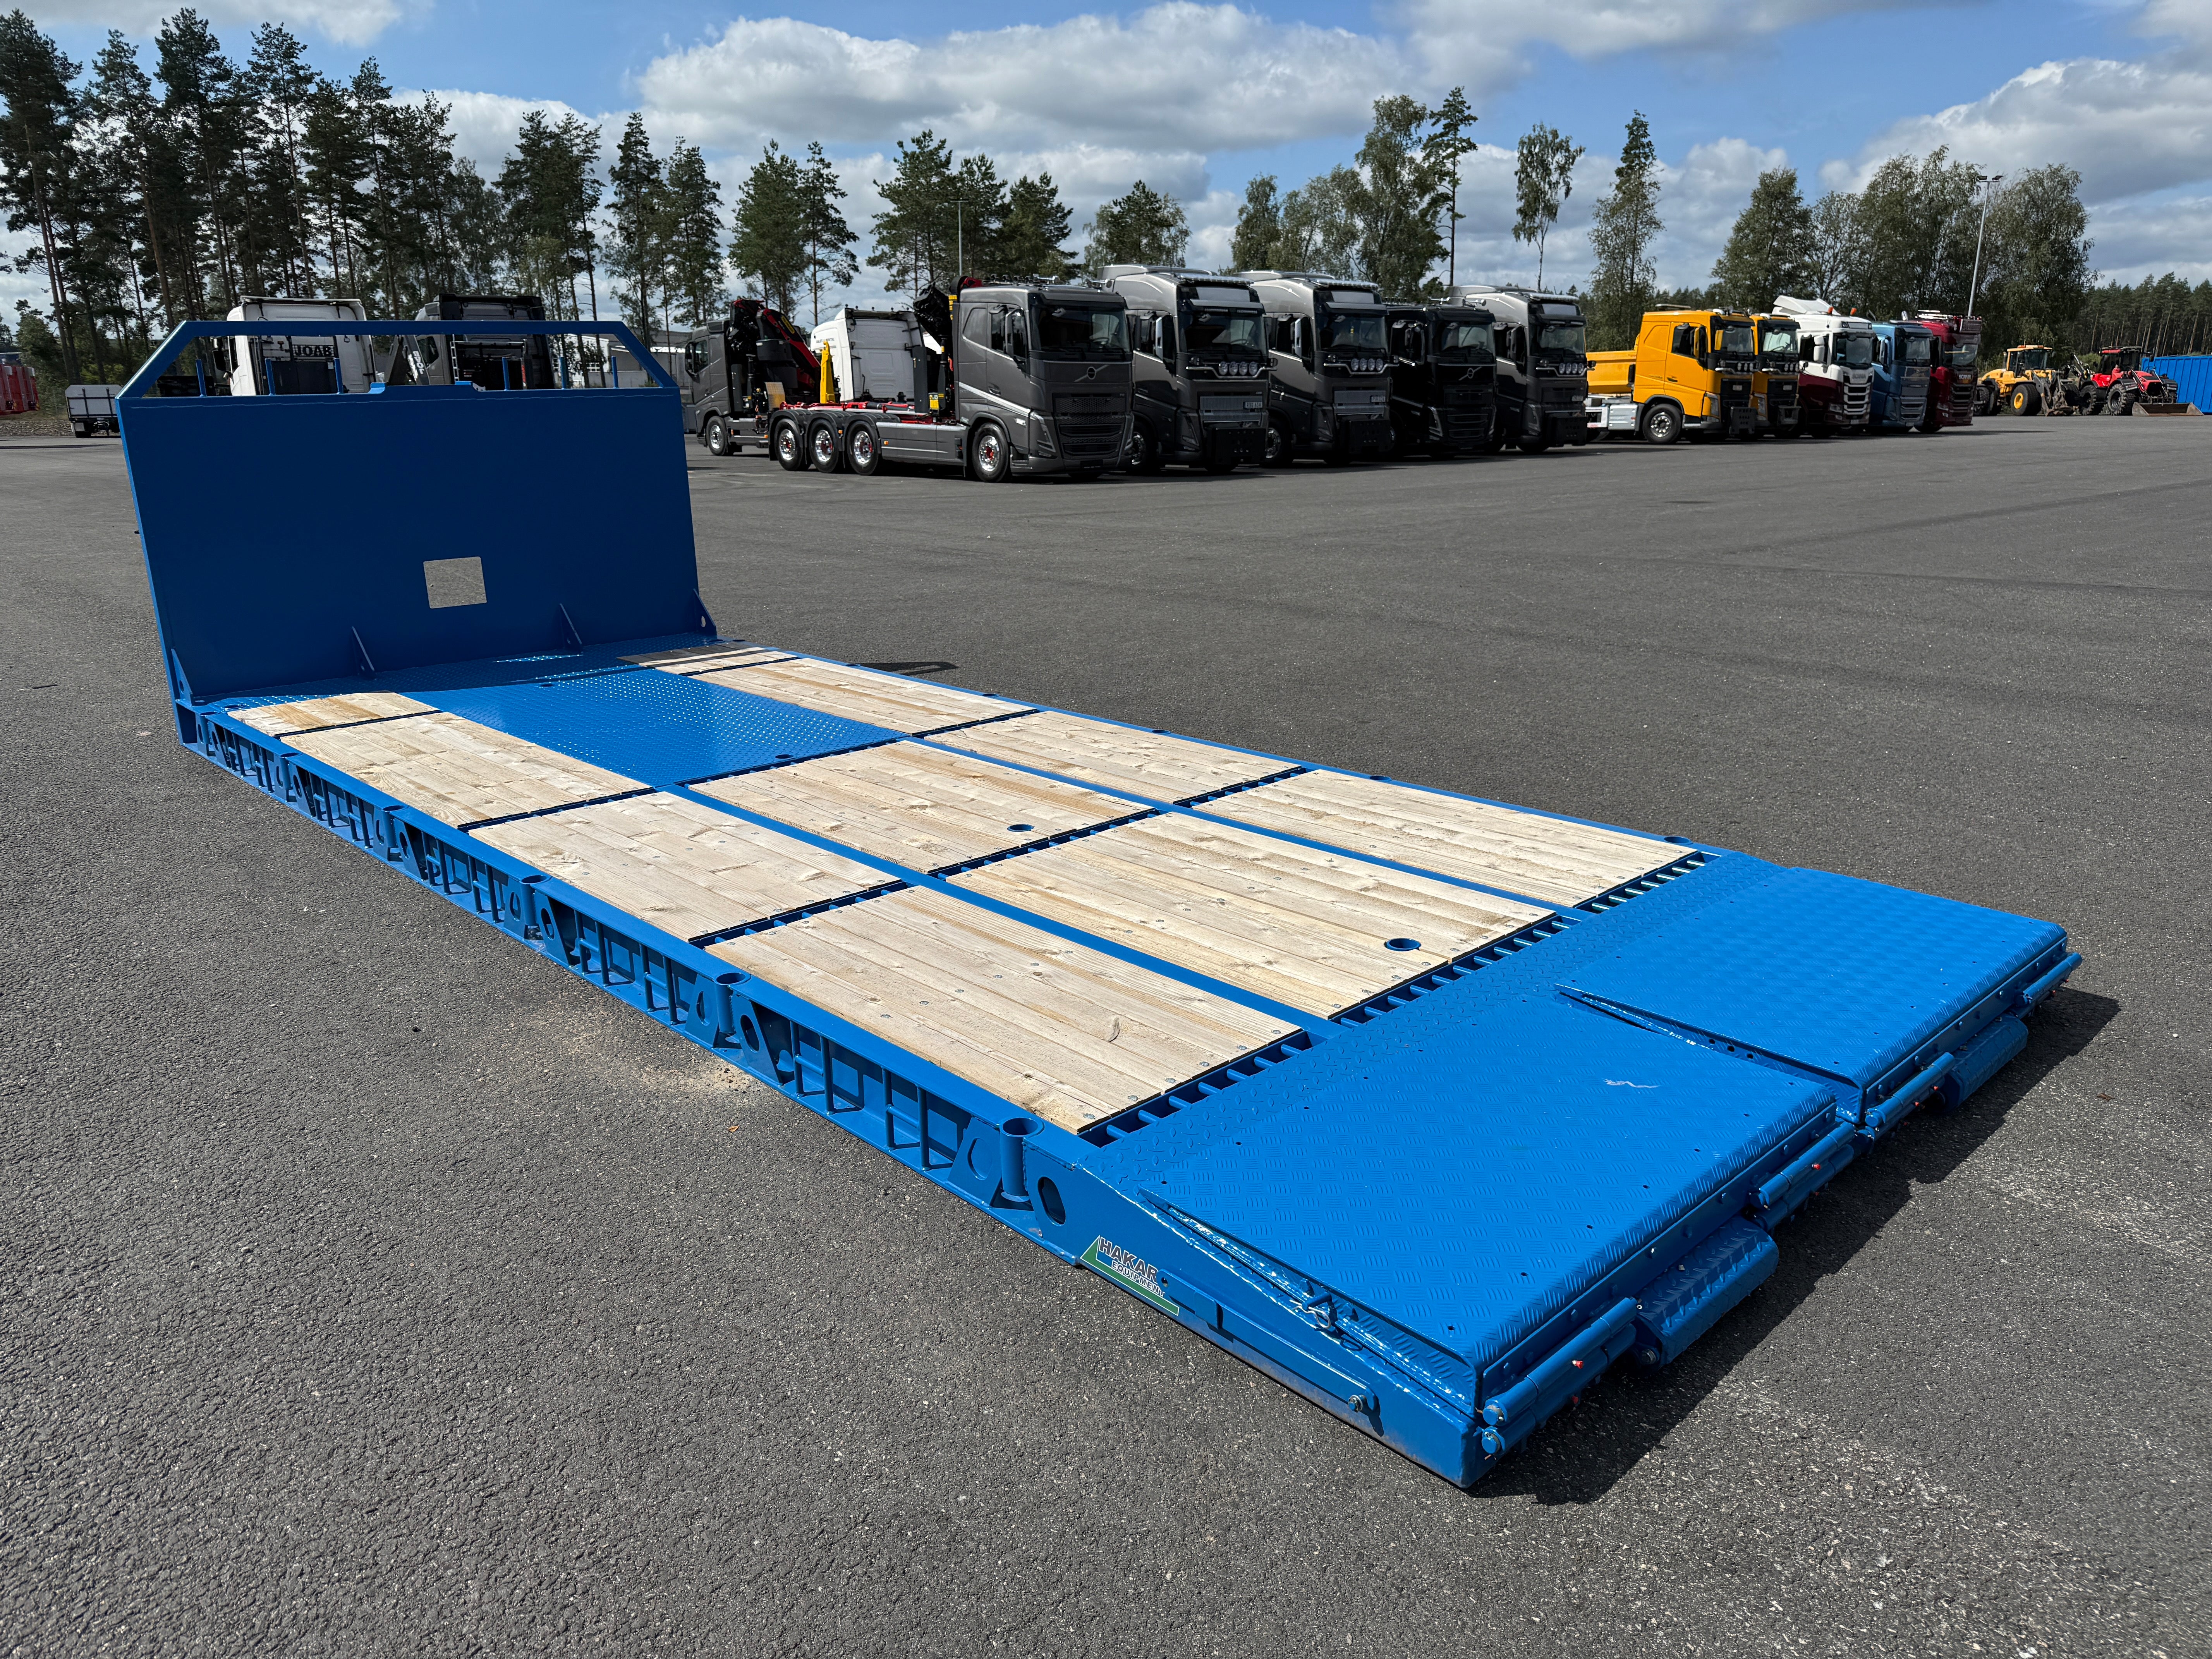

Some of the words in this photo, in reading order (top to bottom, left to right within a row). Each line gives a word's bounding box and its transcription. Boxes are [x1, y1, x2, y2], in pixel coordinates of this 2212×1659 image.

[294, 345, 331, 356] JOAB
[412, 351, 424, 374] JOAB
[1099, 1237, 1158, 1284] HAKAR
